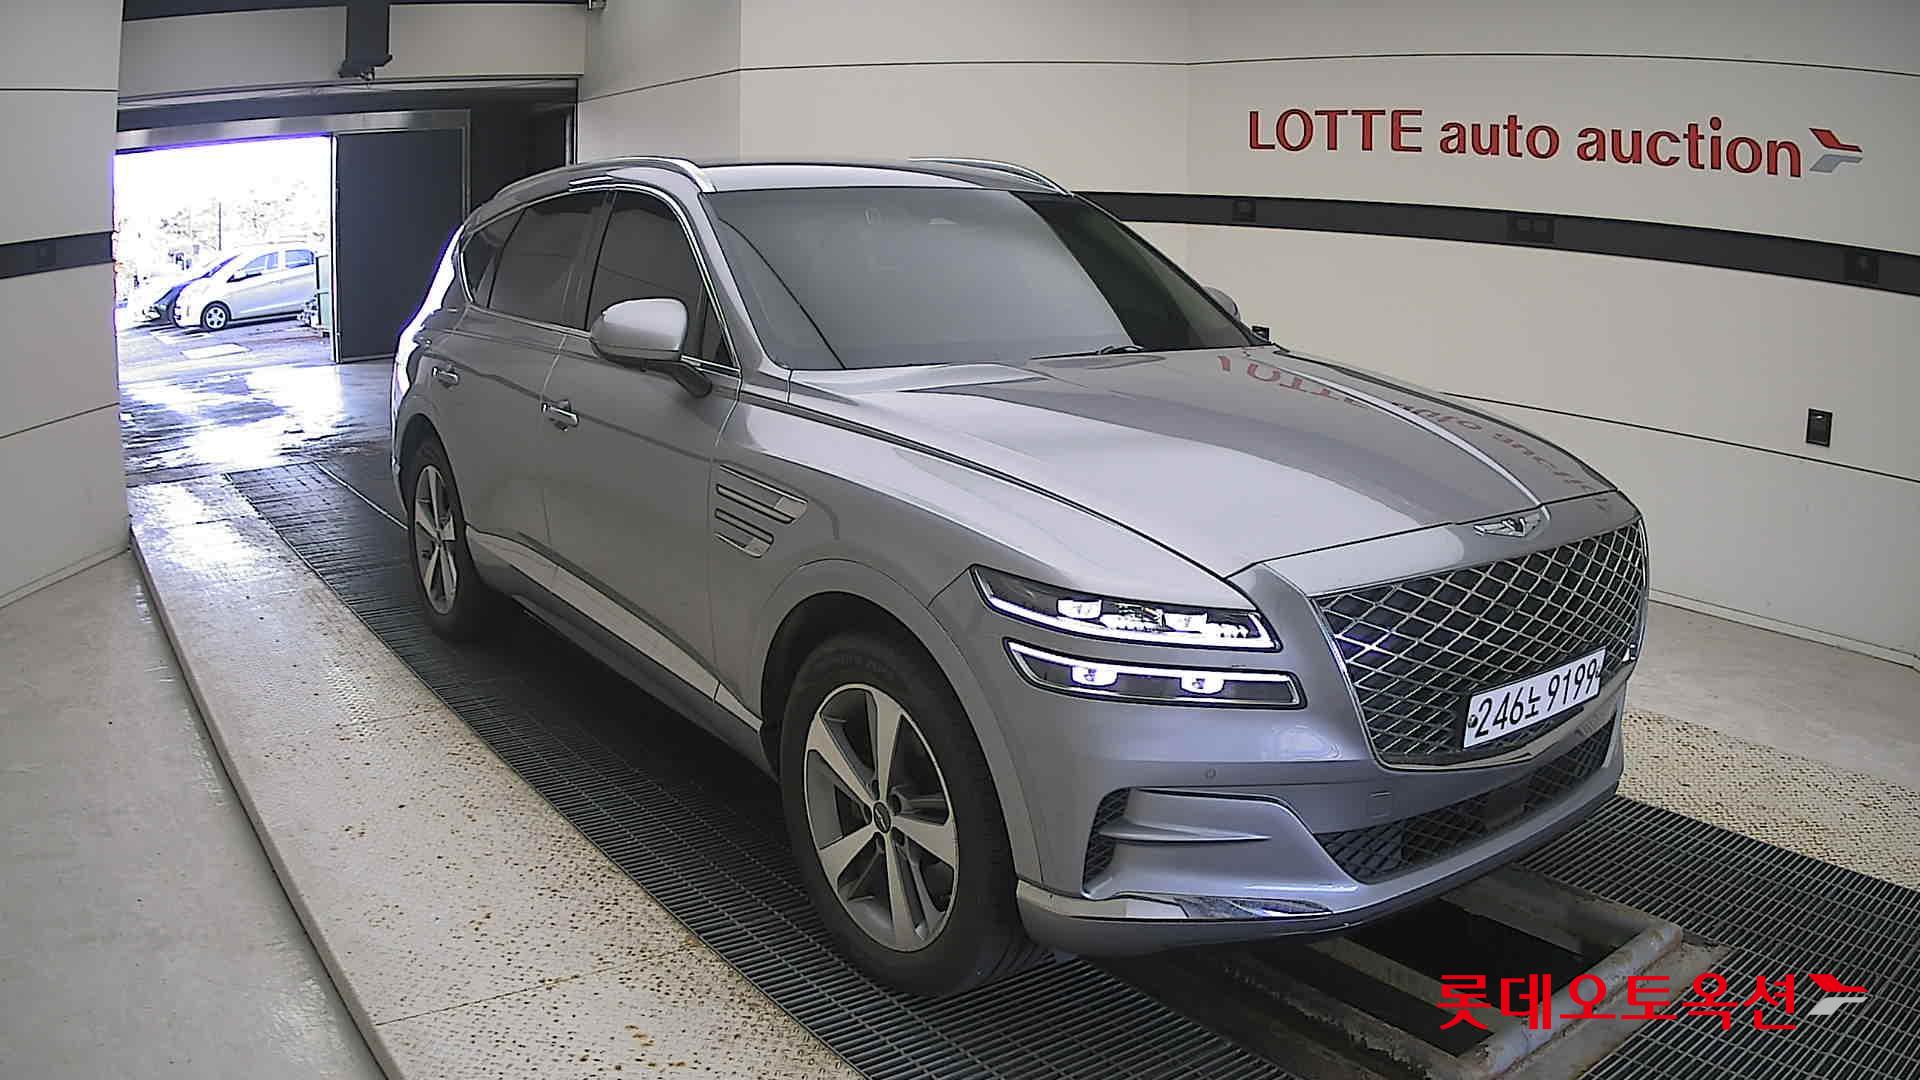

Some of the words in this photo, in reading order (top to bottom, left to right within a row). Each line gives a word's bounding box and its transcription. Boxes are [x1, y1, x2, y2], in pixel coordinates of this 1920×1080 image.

[1249, 109, 1422, 152] LOTTE
[1439, 115, 1560, 159] auto
[1576, 117, 1802, 178] auction
[1475, 686, 1541, 738] 246노
[1546, 658, 1598, 711] 9199
